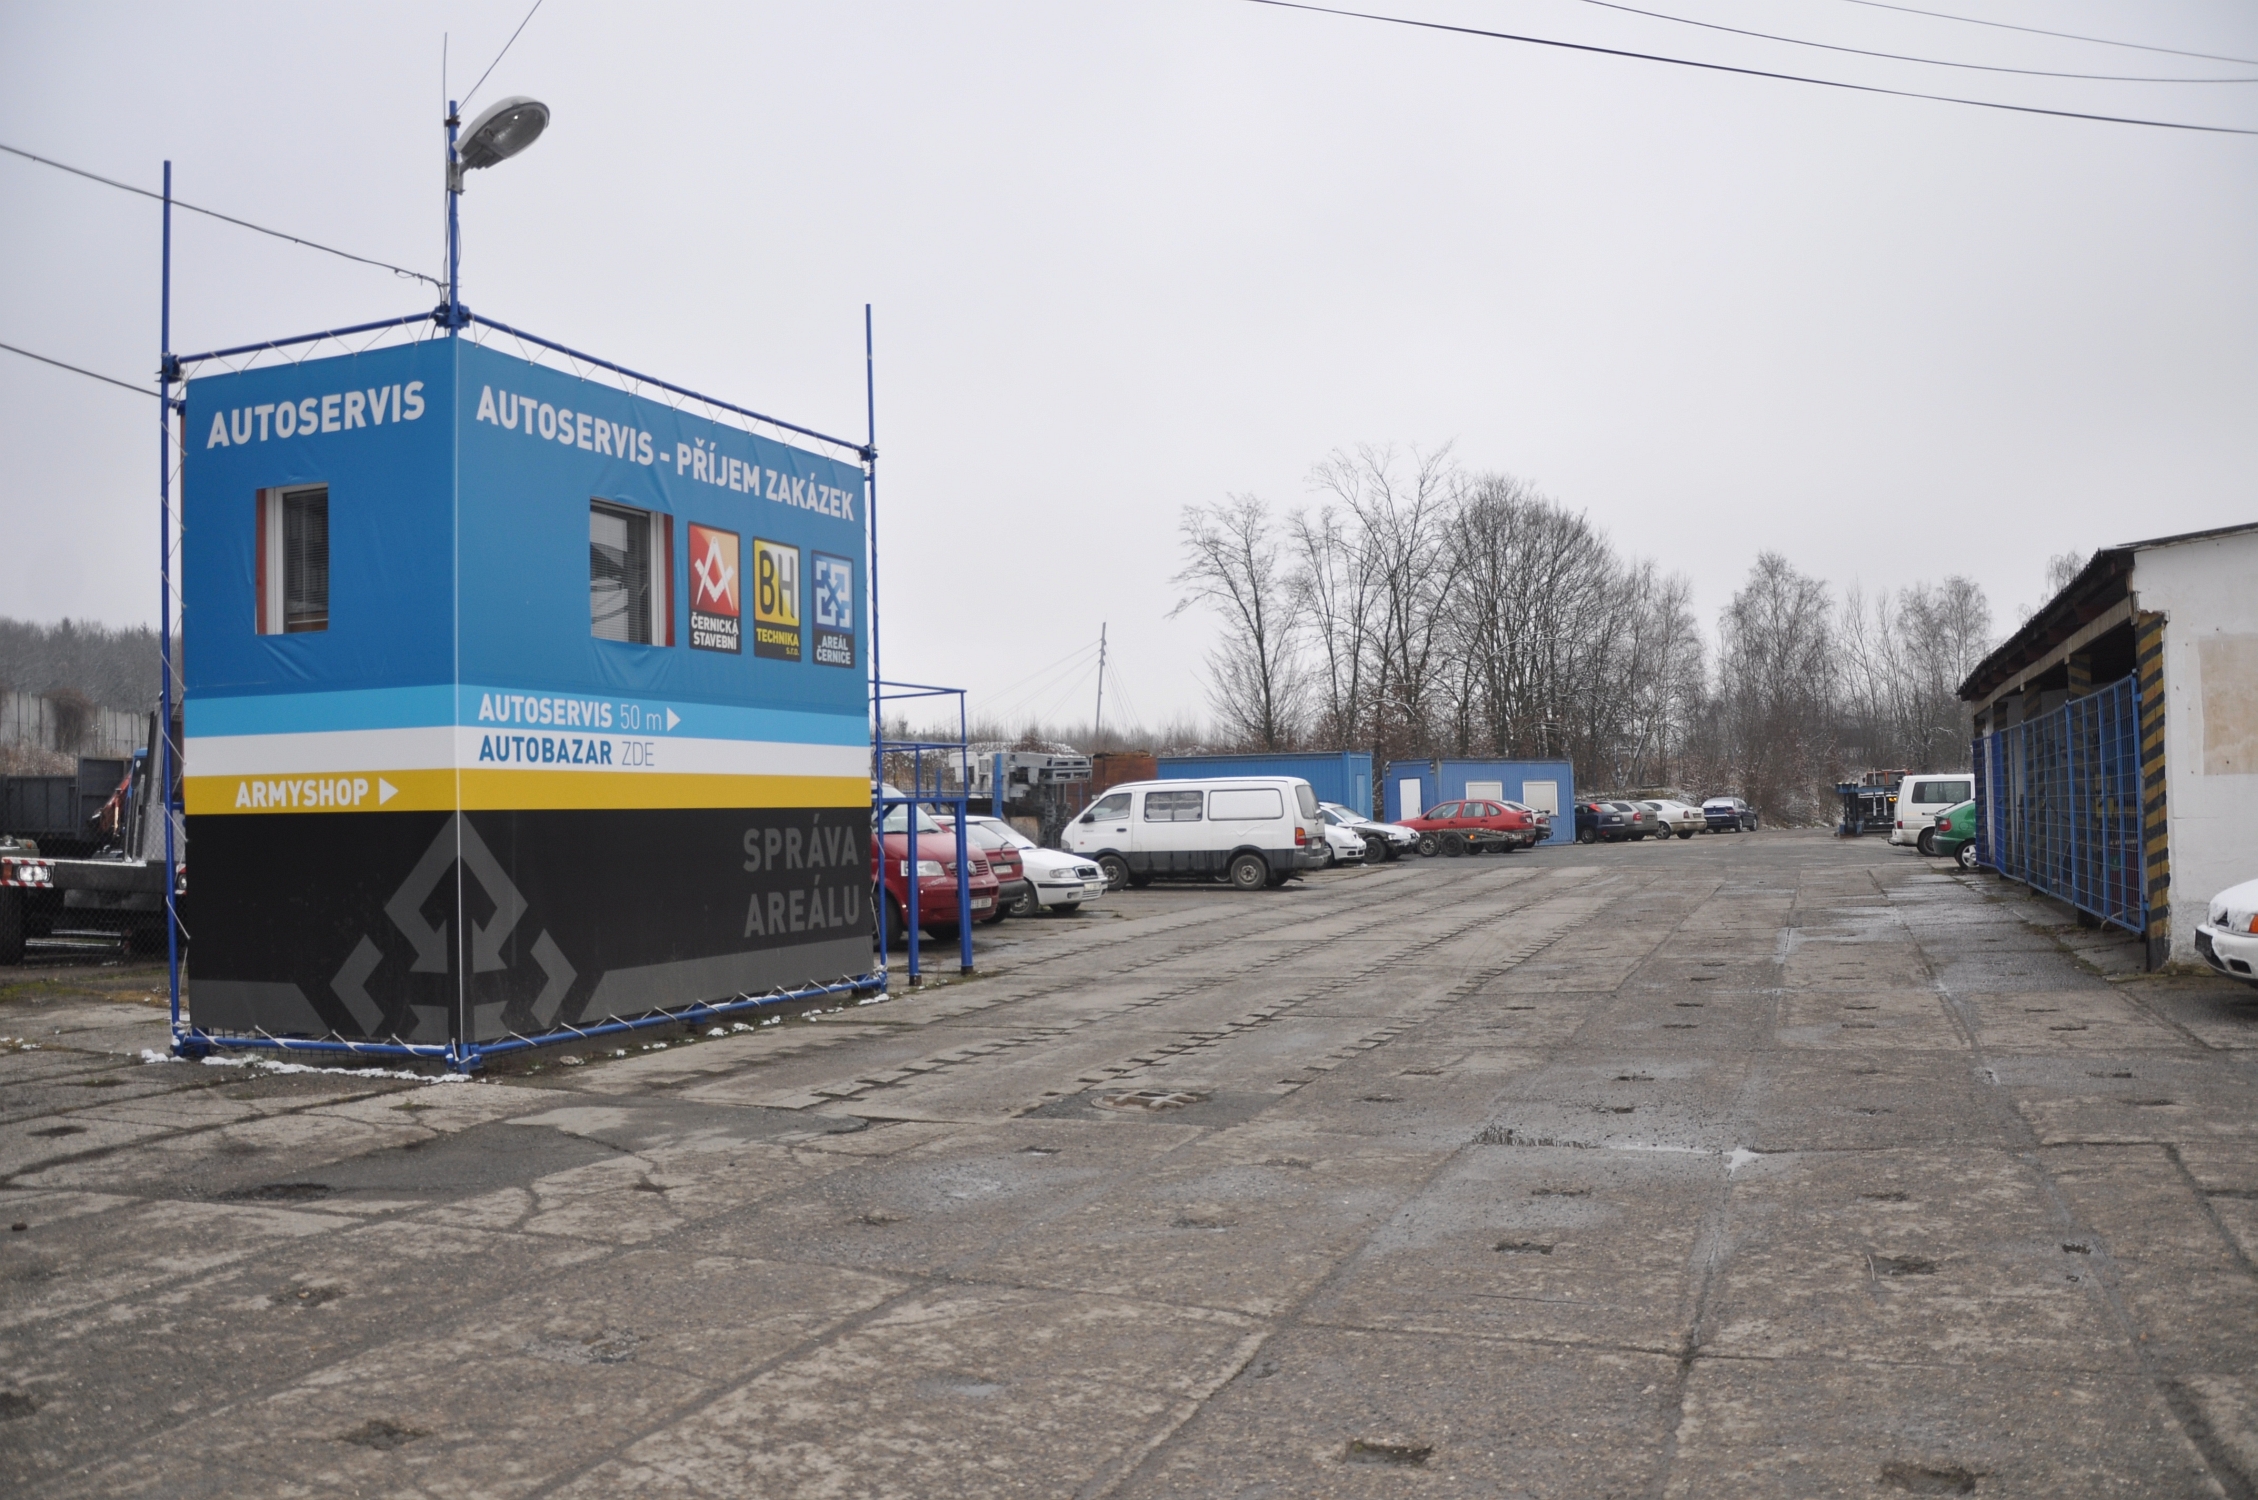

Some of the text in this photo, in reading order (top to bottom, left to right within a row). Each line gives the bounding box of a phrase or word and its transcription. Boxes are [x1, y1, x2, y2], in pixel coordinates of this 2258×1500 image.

[206, 381, 425, 449] AUTOSERVIS
[476, 385, 654, 465] AUTOSERVIS
[677, 437, 760, 496] PŘÍJEM
[765, 469, 855, 522] ZAKÁZEK
[759, 549, 795, 619] BH
[691, 612, 739, 635] ČERNICKÁ
[756, 628, 799, 647] TECHNIKA
[693, 631, 737, 650] STAVEBNÍ
[816, 645, 851, 665] ČERNICE
[821, 635, 848, 651] AREÁL
[478, 693, 662, 731] AUTOSERVIS 50 m
[478, 734, 655, 766] AUTOBAZAR ZDE
[235, 778, 369, 808] ARMYSHOP
[743, 813, 859, 872] SPRÁVA
[744, 874, 860, 938] AREÁLU
